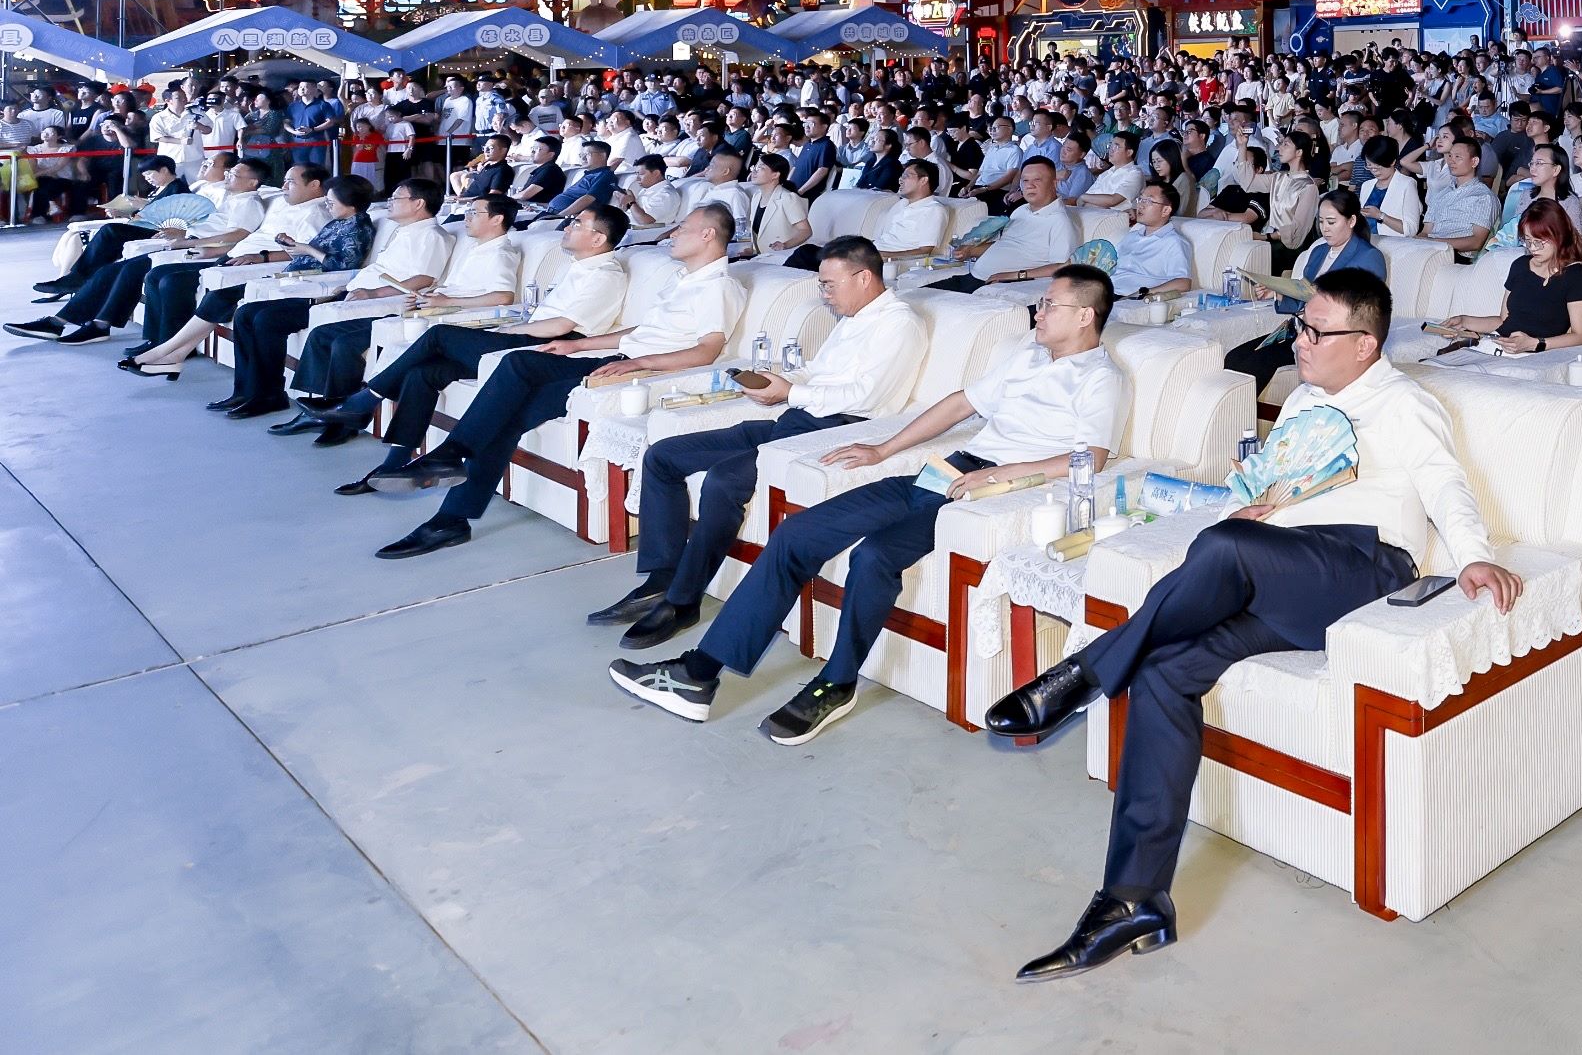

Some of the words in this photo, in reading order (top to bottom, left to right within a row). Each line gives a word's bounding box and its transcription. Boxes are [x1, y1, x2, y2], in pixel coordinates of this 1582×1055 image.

[216, 32, 333, 46] 八里湖新区
[480, 28, 544, 42] 修水县
[681, 27, 734, 41] 柴桑区
[844, 26, 905, 39] 共青城市
